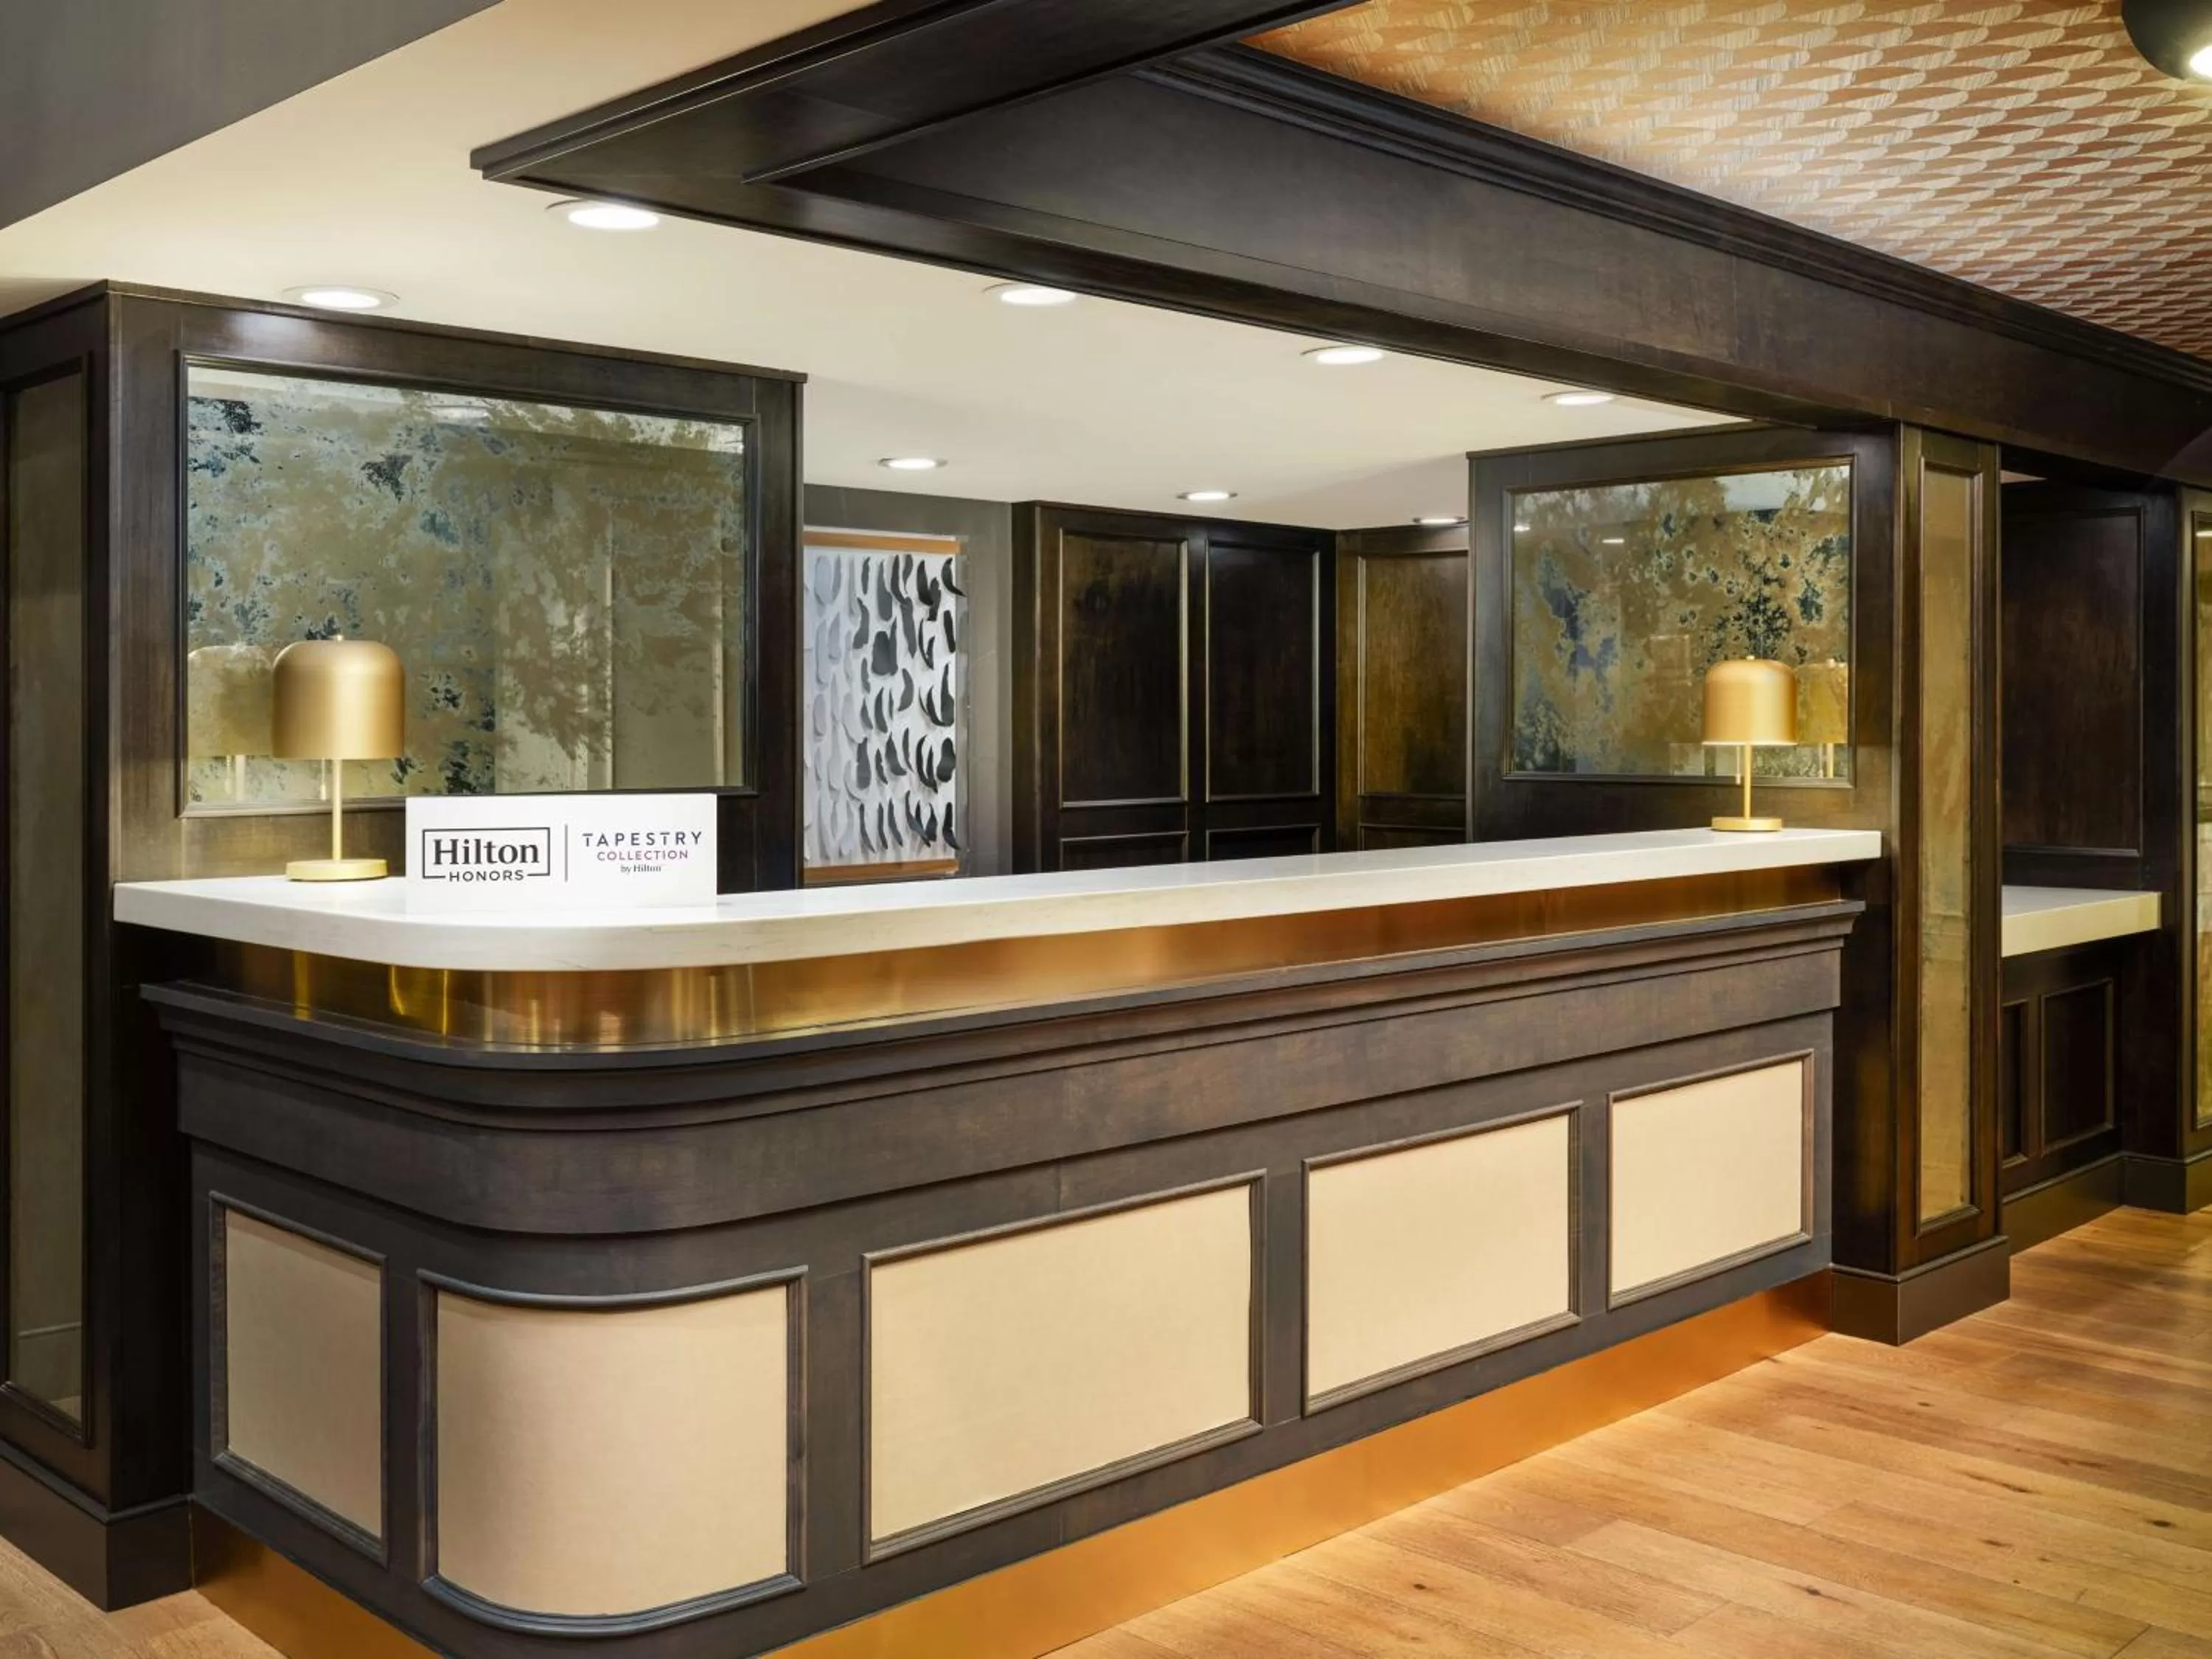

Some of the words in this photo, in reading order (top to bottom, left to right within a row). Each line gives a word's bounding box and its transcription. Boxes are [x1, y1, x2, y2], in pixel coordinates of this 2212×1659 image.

[582, 831, 703, 847] TAPESTRY
[433, 838, 540, 866] Hilton
[597, 849, 689, 861] COLLECTION
[448, 869, 525, 883] HONORS
[620, 865, 631, 874] by
[633, 864, 662, 872] Hilton
